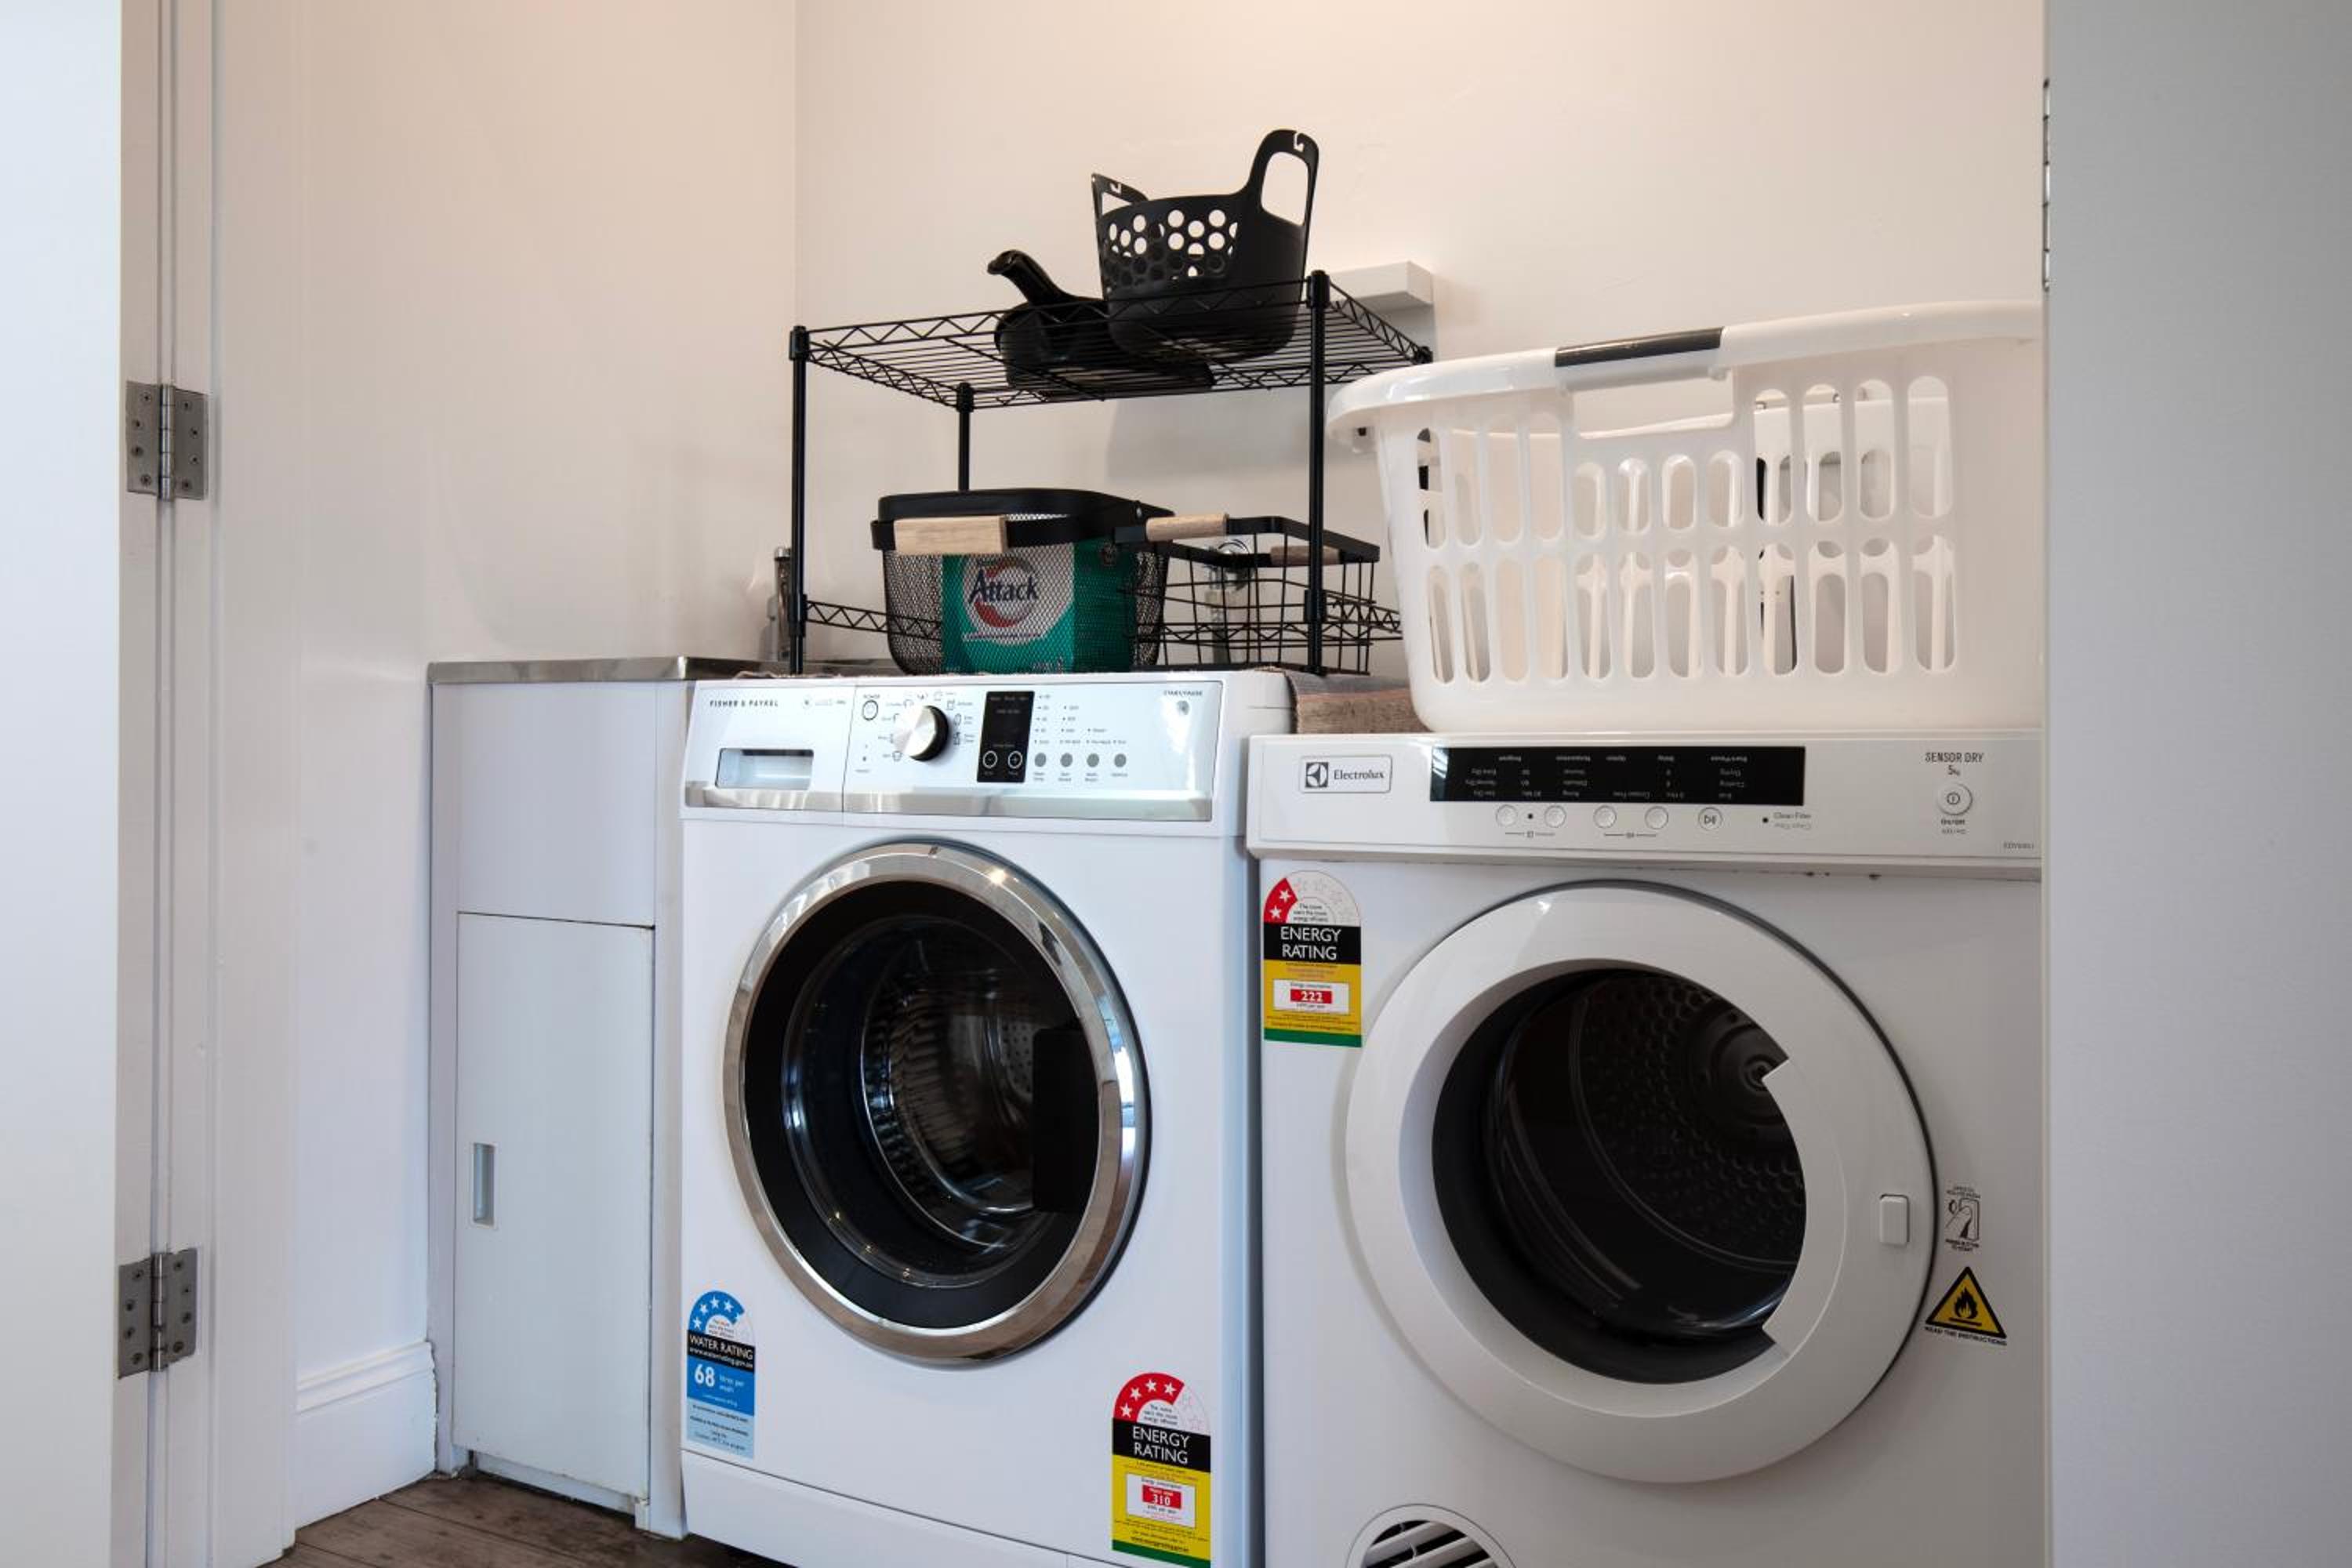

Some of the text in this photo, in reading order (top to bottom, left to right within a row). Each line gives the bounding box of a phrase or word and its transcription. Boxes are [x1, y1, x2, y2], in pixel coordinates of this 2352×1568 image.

[968, 570, 1039, 603] Attack
[1925, 752, 1984, 763] SENSOR DRY
[1334, 769, 1385, 780] Electrolux
[1280, 927, 1341, 942] ENERGY
[1282, 944, 1337, 960] RATING
[689, 1334, 753, 1360] WATER RATING
[694, 1363, 716, 1388] 68
[1133, 1426, 1189, 1448] ENERGY
[1134, 1443, 1188, 1465] RATING
[1152, 1494, 1171, 1506] 310
